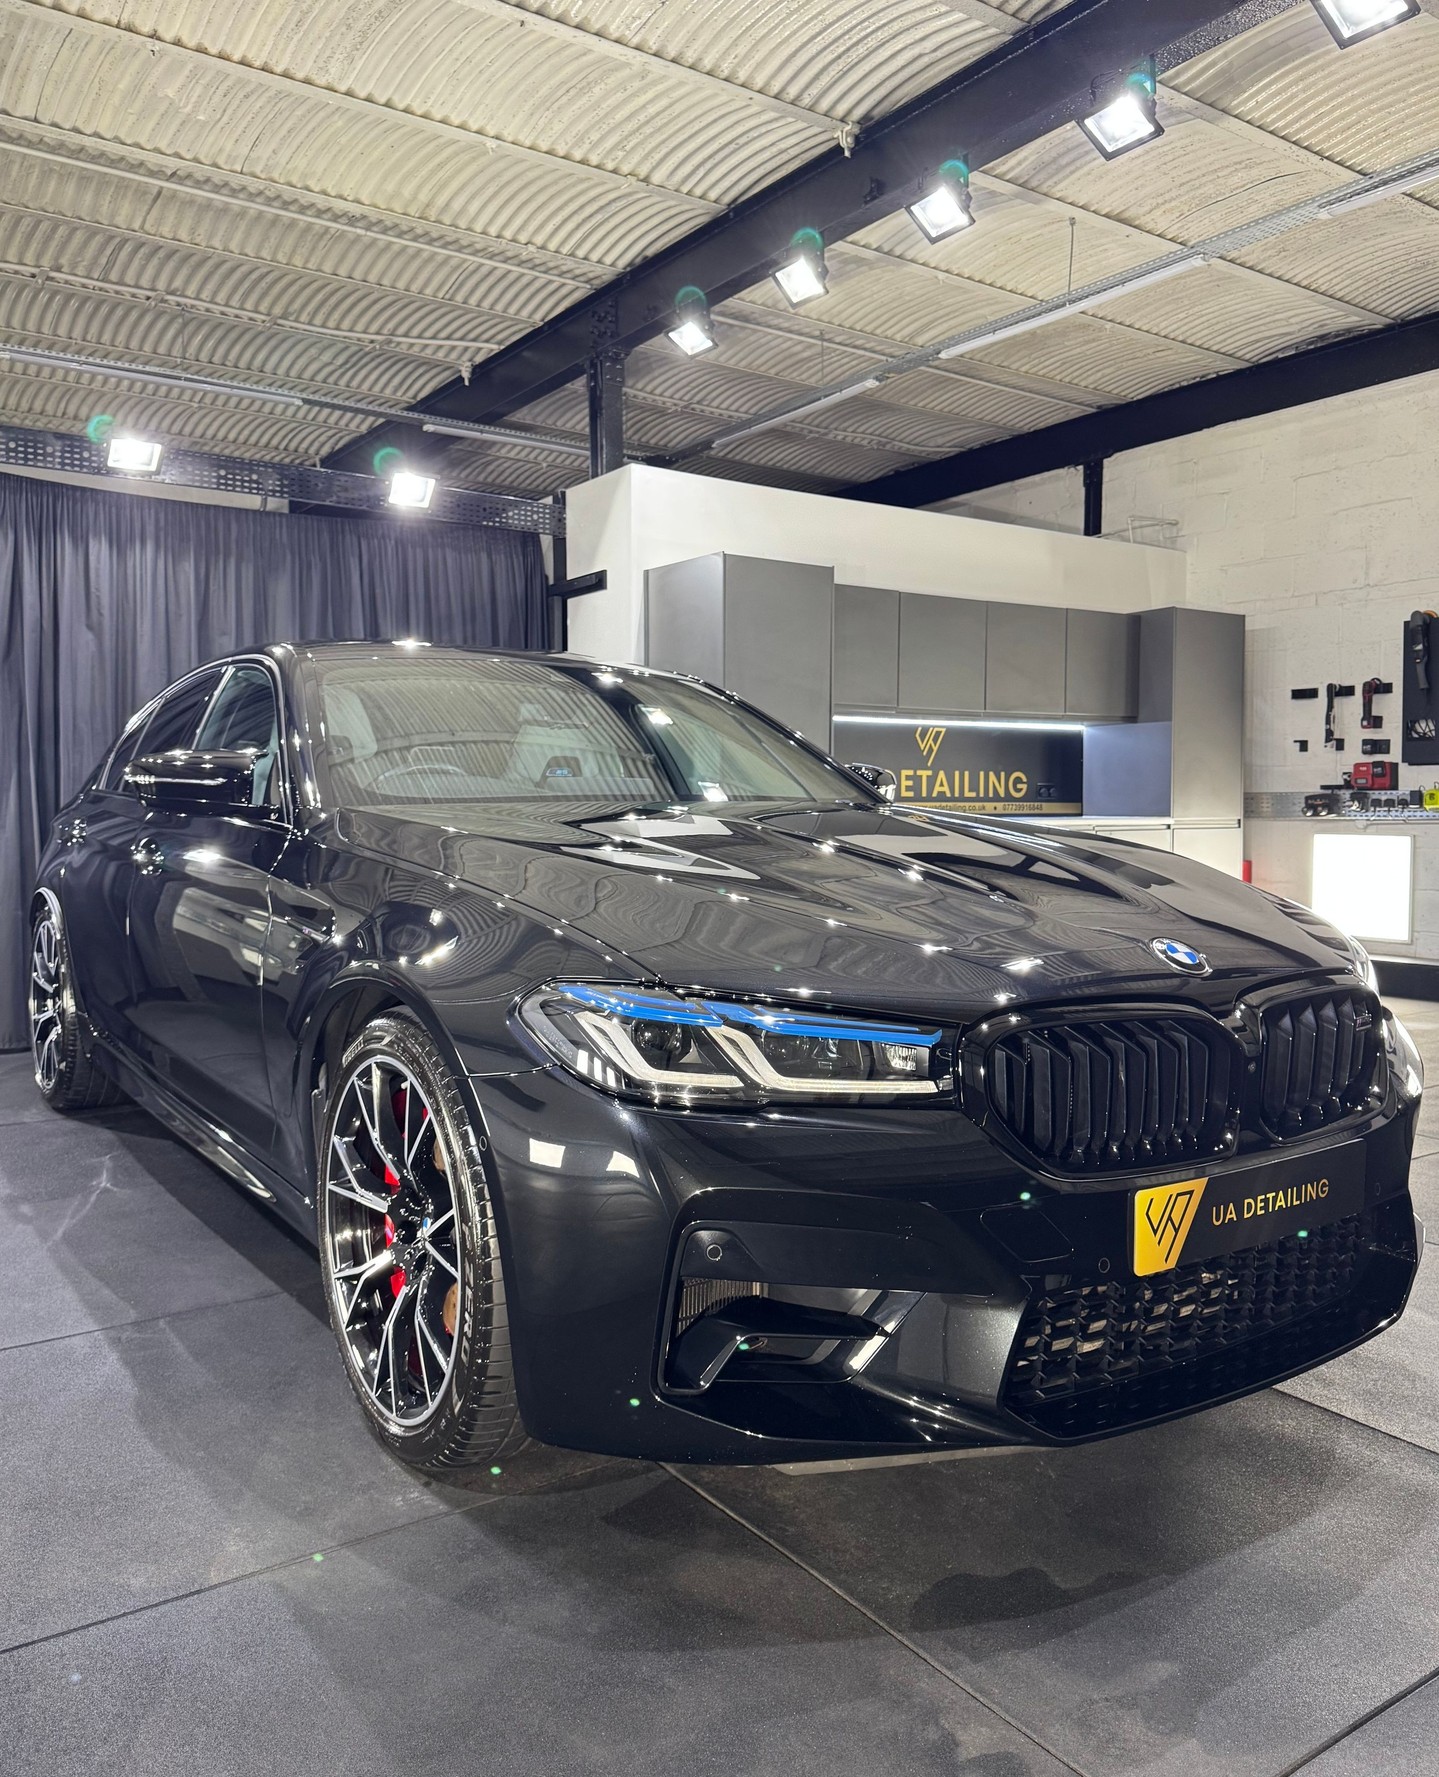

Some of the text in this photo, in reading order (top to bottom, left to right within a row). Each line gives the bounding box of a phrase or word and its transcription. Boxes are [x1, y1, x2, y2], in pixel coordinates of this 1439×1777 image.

[900, 769, 1028, 798] ETAILING
[1212, 1178, 1329, 1225] UA DETAILING
[460, 1256, 474, 1367] ZERO
